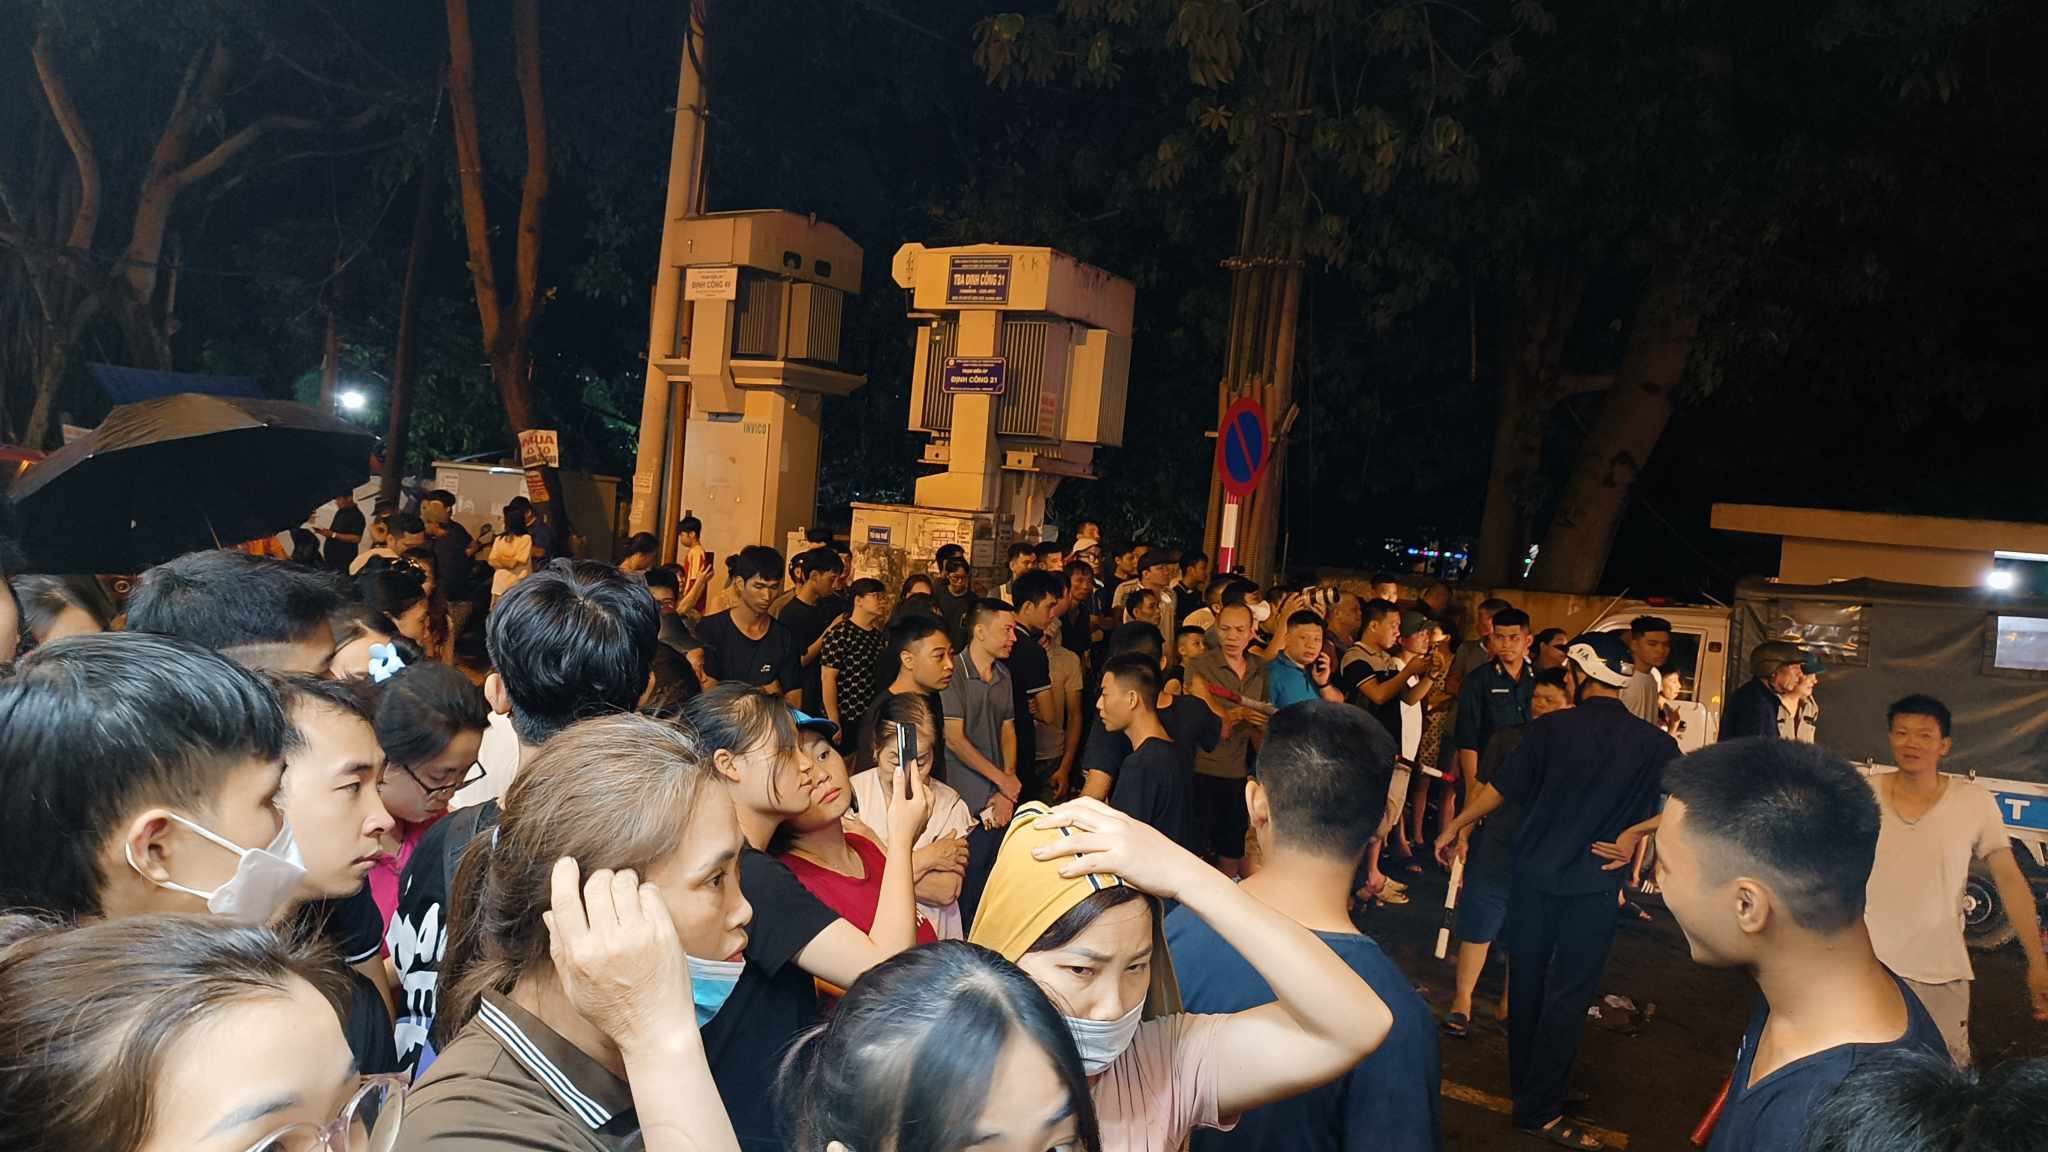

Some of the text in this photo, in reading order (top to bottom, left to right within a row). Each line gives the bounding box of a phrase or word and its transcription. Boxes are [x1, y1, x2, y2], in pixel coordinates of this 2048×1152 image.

[997, 273, 1005, 286] 21
[969, 374, 989, 384] CÔNG
[743, 423, 767, 435] INVICO
[522, 435, 555, 448] MUA
[2004, 798, 2031, 820] T
